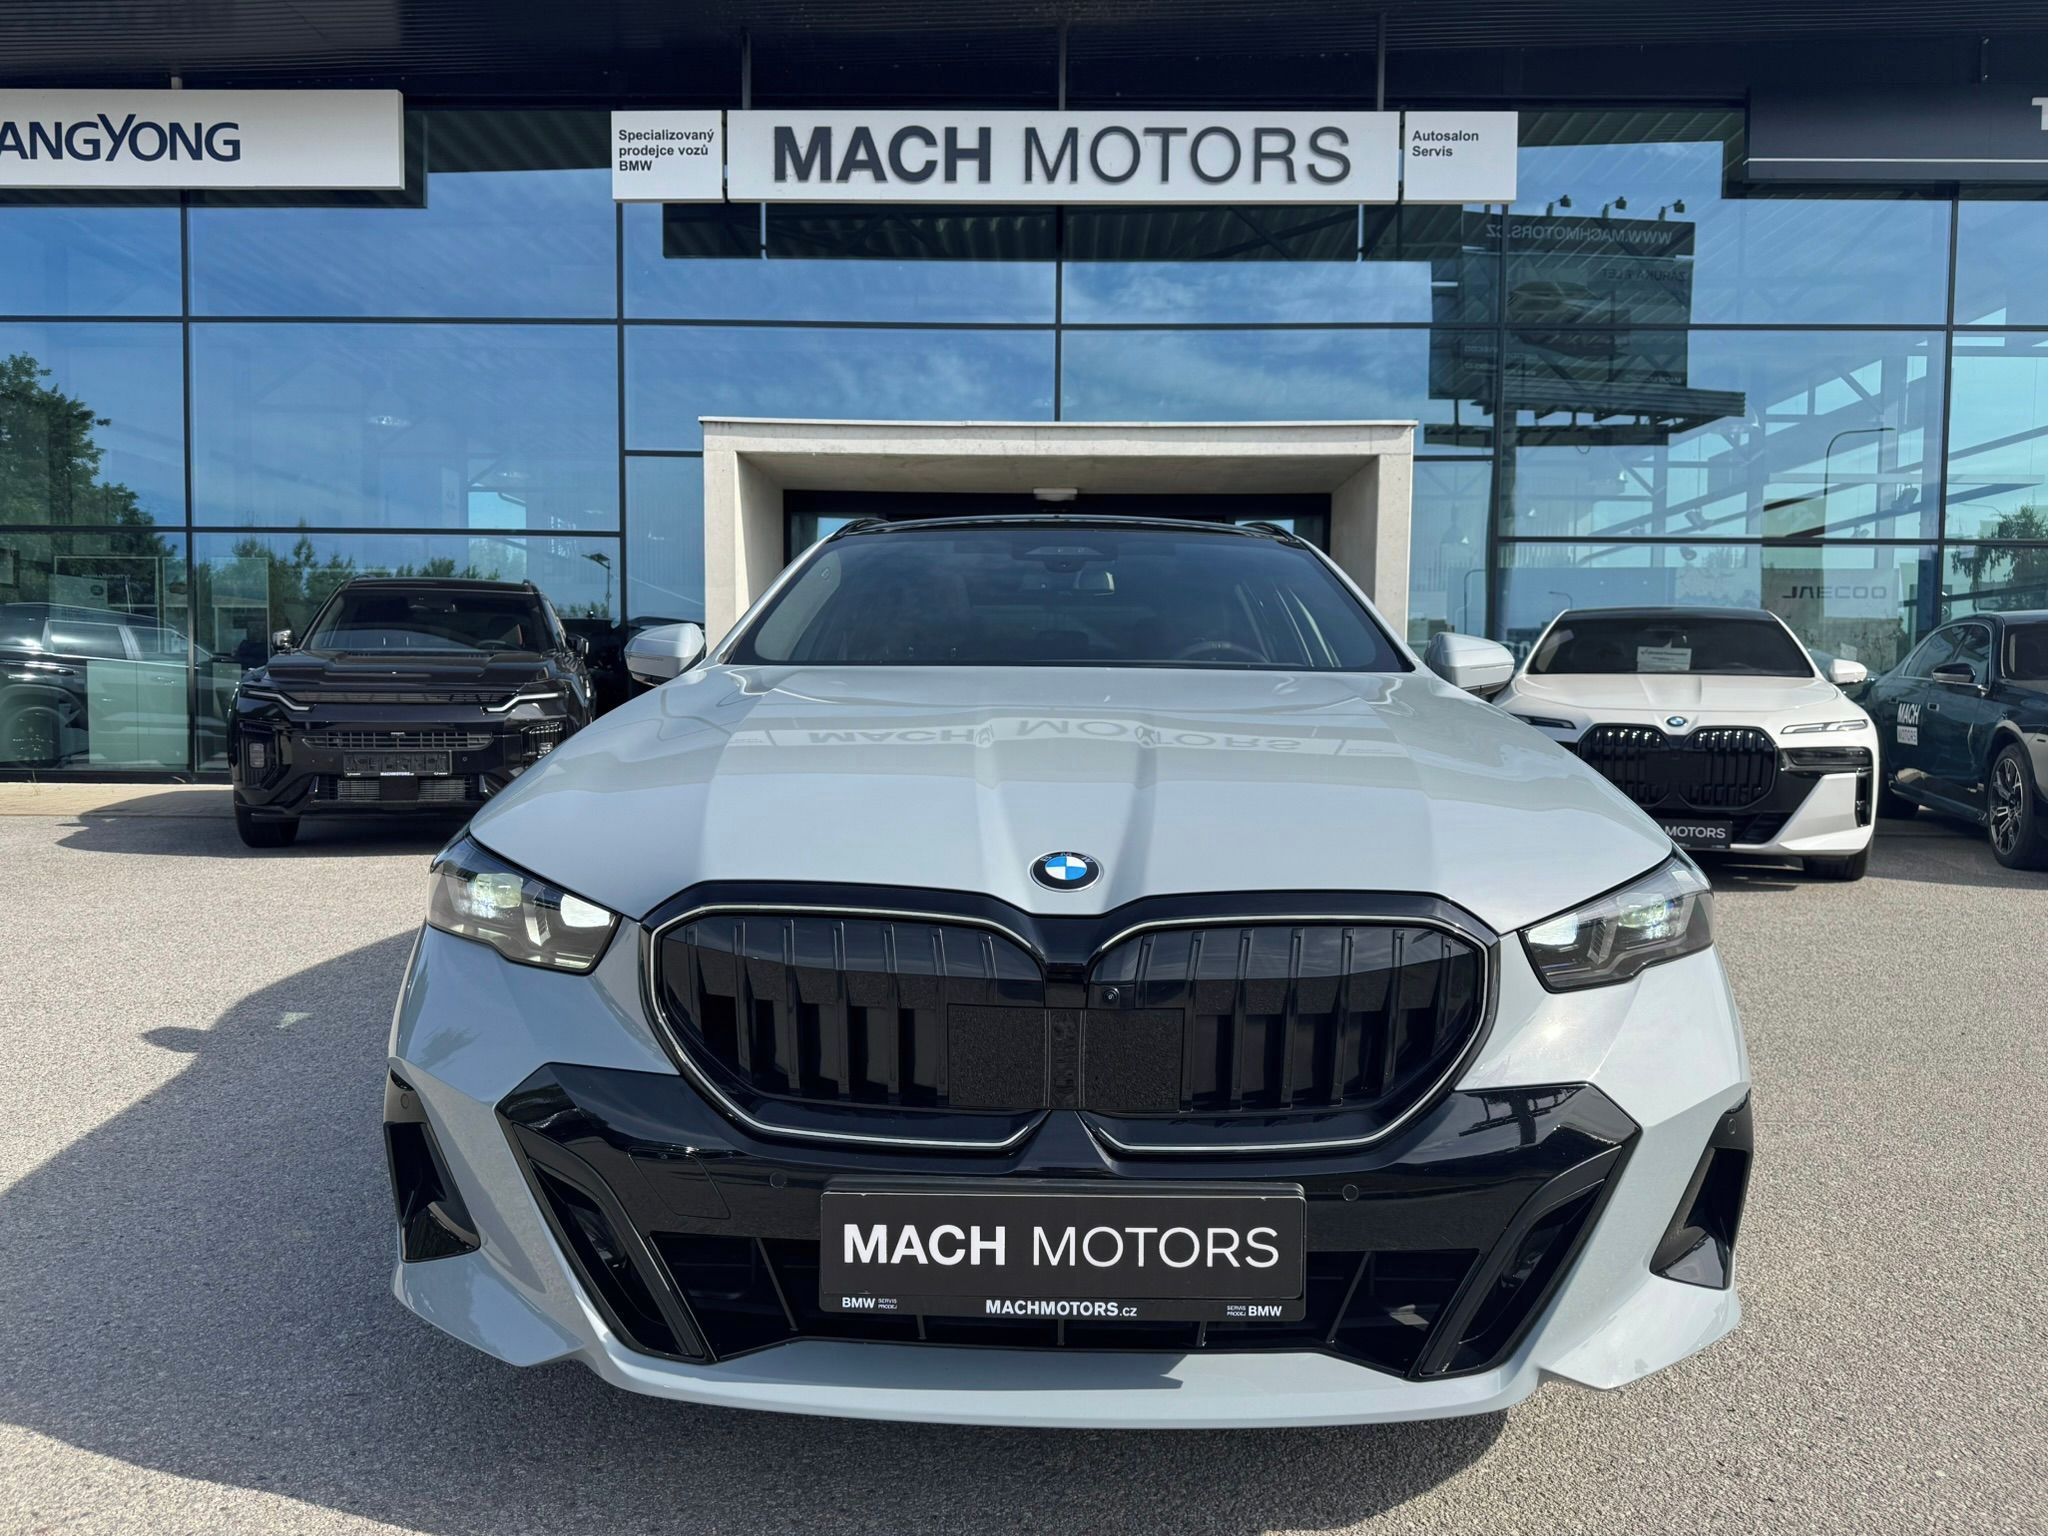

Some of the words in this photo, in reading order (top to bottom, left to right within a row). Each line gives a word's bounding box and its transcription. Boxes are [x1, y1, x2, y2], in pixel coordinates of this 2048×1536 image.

[618, 128, 715, 143] Specializovaný
[1411, 130, 1480, 142] Autosalon
[618, 145, 675, 158] prodejce
[677, 144, 709, 157] vozů
[774, 125, 992, 184] MACH
[1023, 125, 1352, 184] MOTORS
[1411, 145, 1454, 157] Servis
[619, 160, 653, 172] BMW
[1781, 585, 1888, 599] JAECOO
[1896, 703, 1921, 725] MACH
[1664, 825, 1726, 839] MOTORS
[843, 1223, 1006, 1266] MACH
[1033, 1225, 1280, 1269] MOTORS
[842, 1297, 876, 1309] BMW
[985, 1299, 1138, 1317] MACHMOTORS.cz
[1248, 1305, 1283, 1317] BMW
